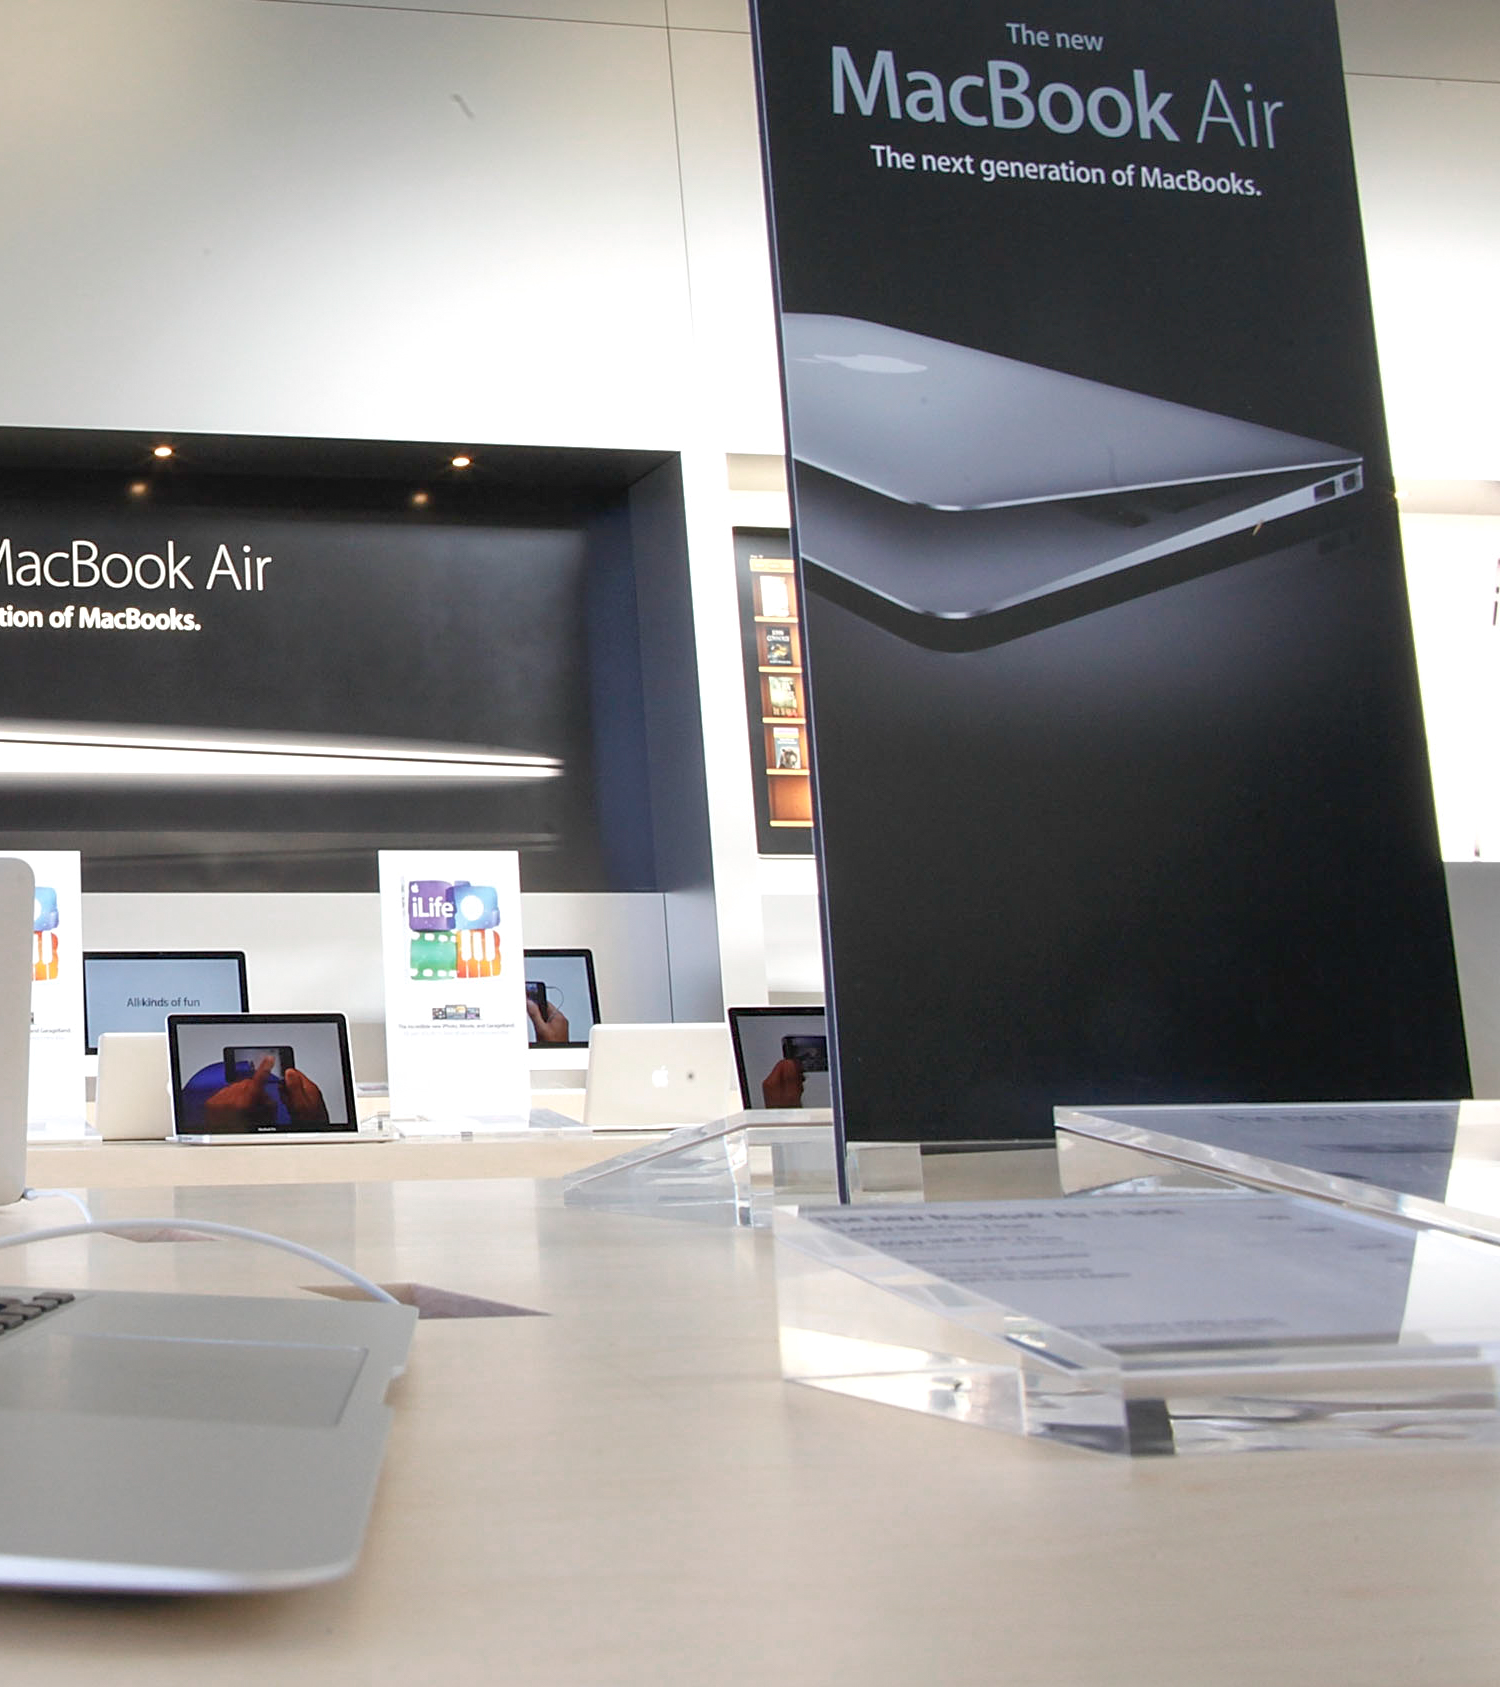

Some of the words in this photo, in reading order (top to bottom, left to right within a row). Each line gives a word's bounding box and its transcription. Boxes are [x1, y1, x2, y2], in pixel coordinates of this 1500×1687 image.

[1005, 22, 1049, 48] The
[1056, 30, 1104, 52] new
[830, 45, 1181, 142] MacBook
[1196, 78, 1284, 149] Air
[870, 144, 916, 171] The
[921, 153, 975, 176] next
[980, 157, 1105, 185] generation
[1112, 163, 1136, 188] of
[1140, 166, 1262, 197] MacBooks.
[206, 544, 273, 592] Air
[49, 605, 75, 629] of
[78, 606, 203, 631] MacBooks.
[412, 896, 454, 918] iLife
[126, 997, 140, 1008] All
[141, 997, 169, 1008] kinds
[170, 997, 181, 1007] of
[183, 997, 201, 1007] fun
